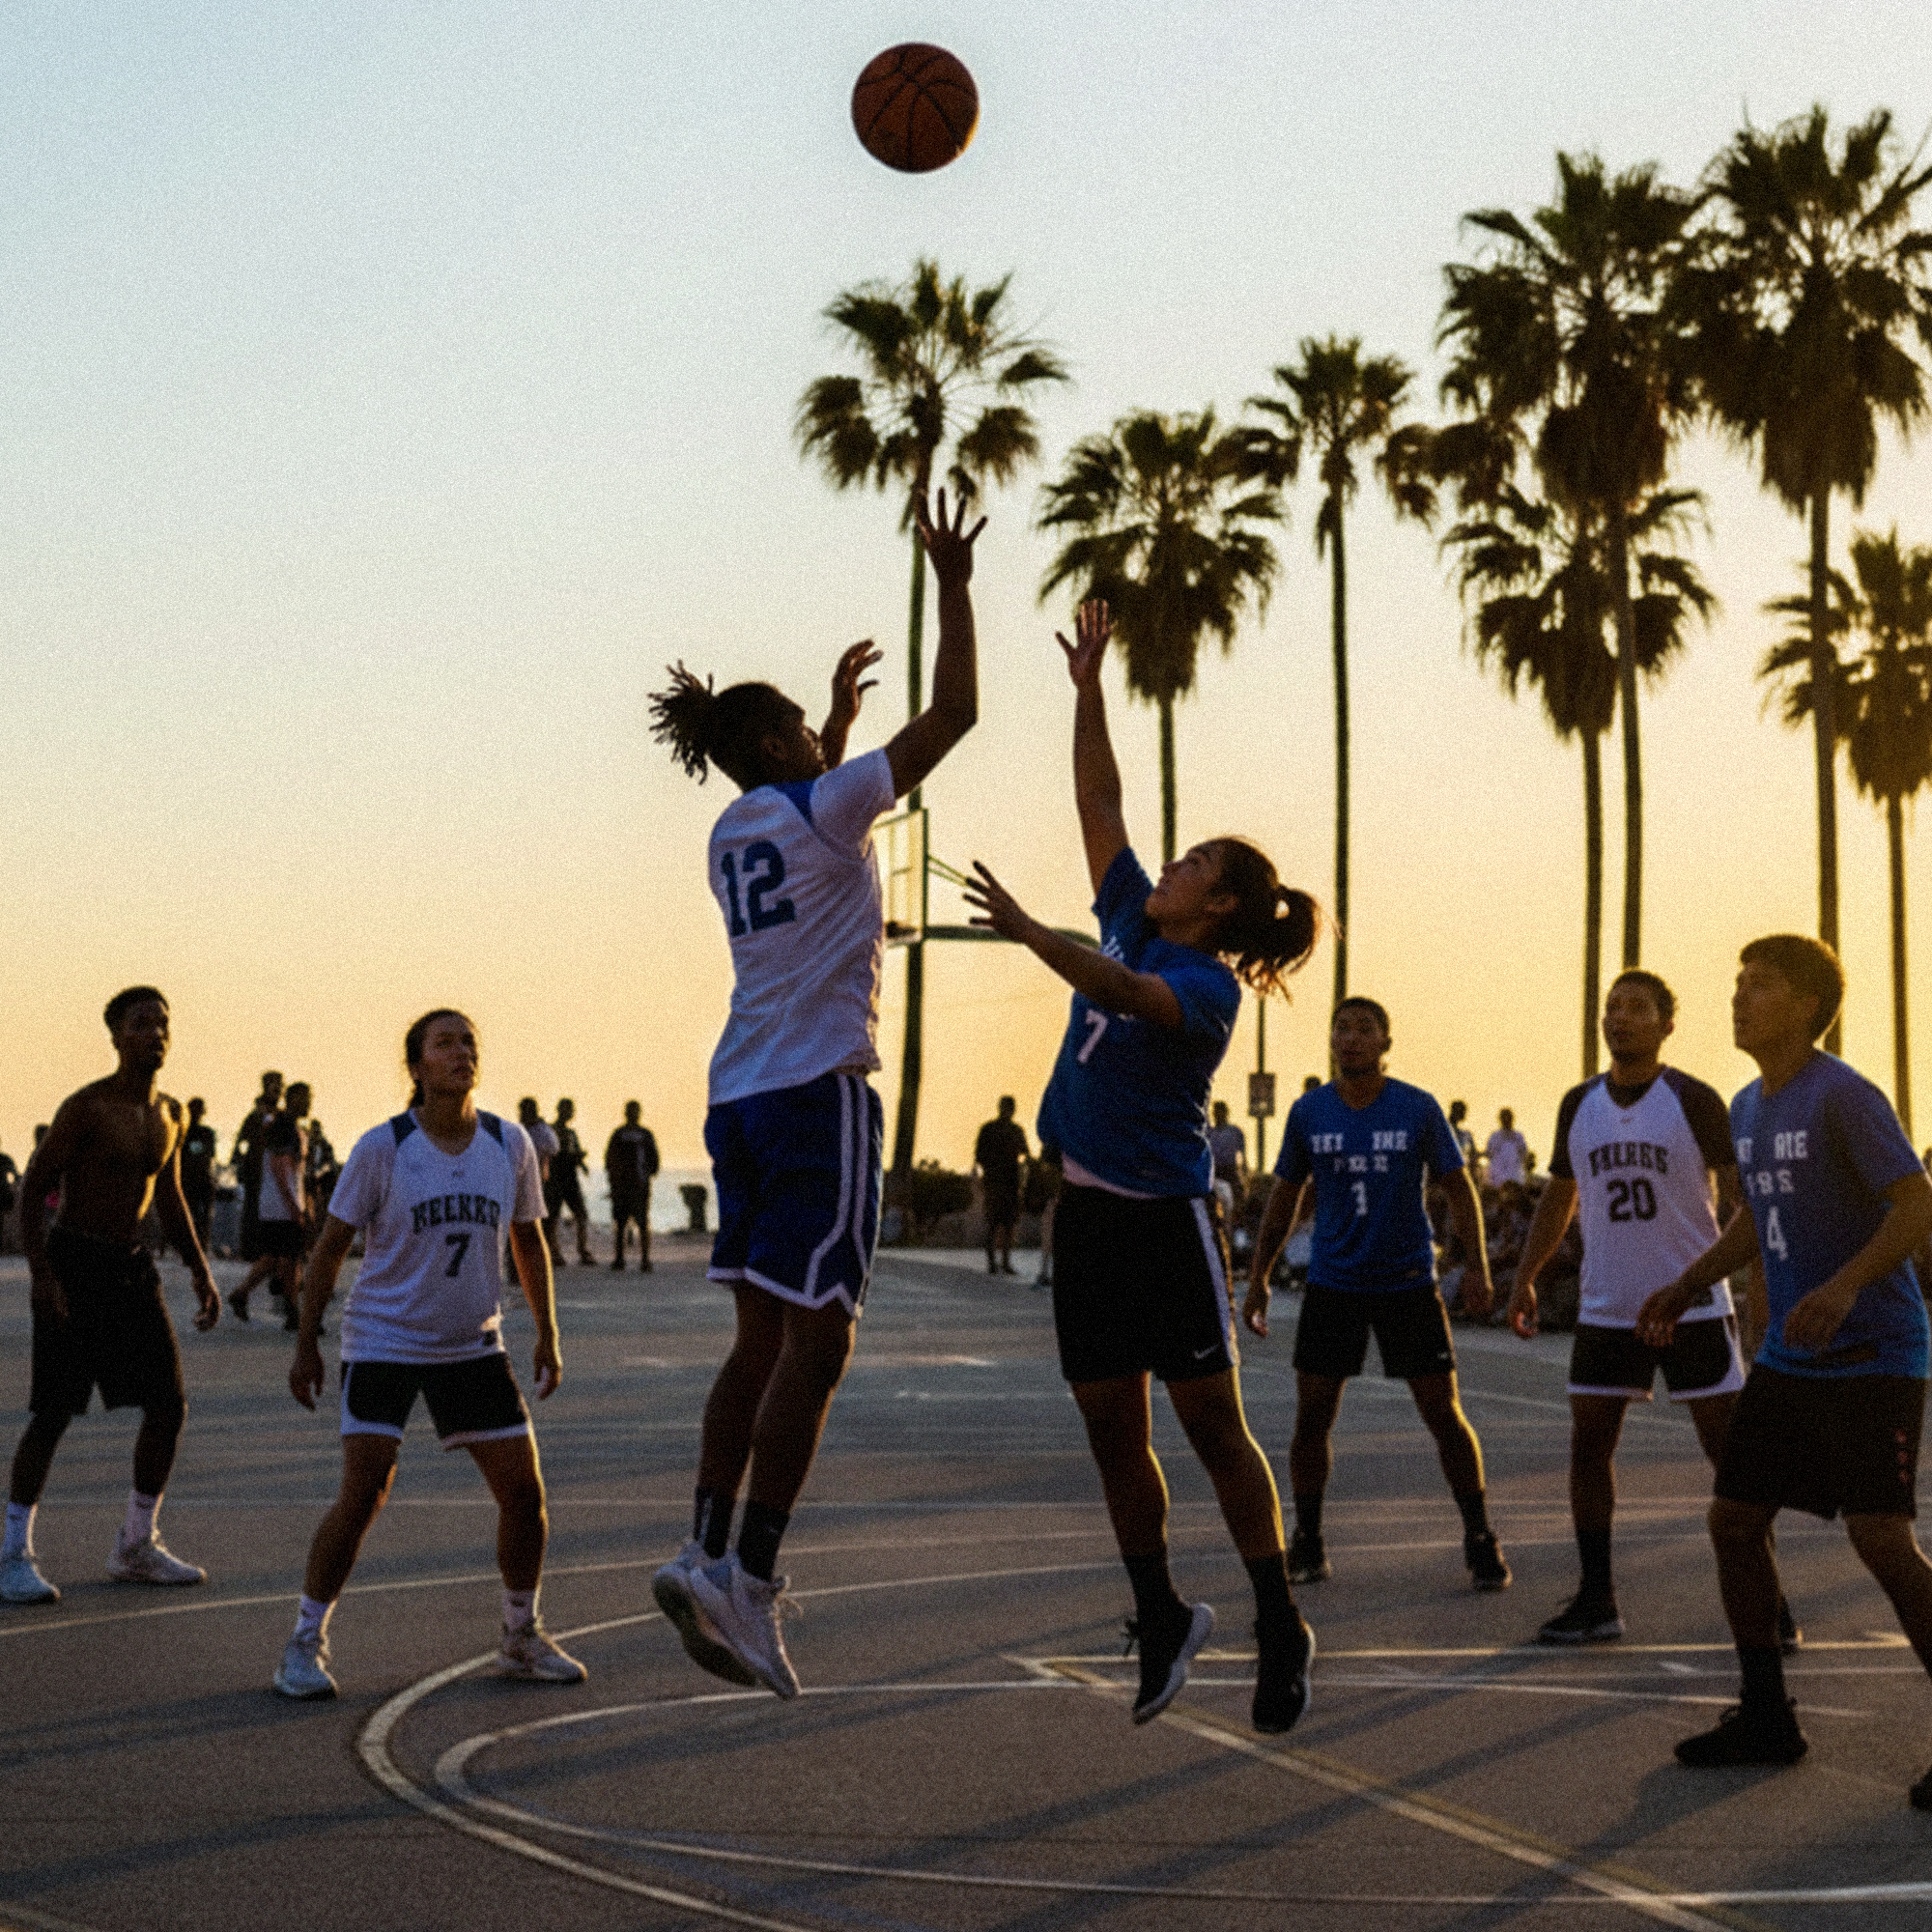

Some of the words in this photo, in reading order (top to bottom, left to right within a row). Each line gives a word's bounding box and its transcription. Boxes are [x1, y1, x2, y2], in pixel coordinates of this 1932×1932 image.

[722, 839, 796, 937] 12
[1077, 1008, 1109, 1064] 7
[1606, 1177, 1659, 1223] 20
[445, 1234, 470, 1277] 7
[1767, 1206, 1788, 1261] 4
